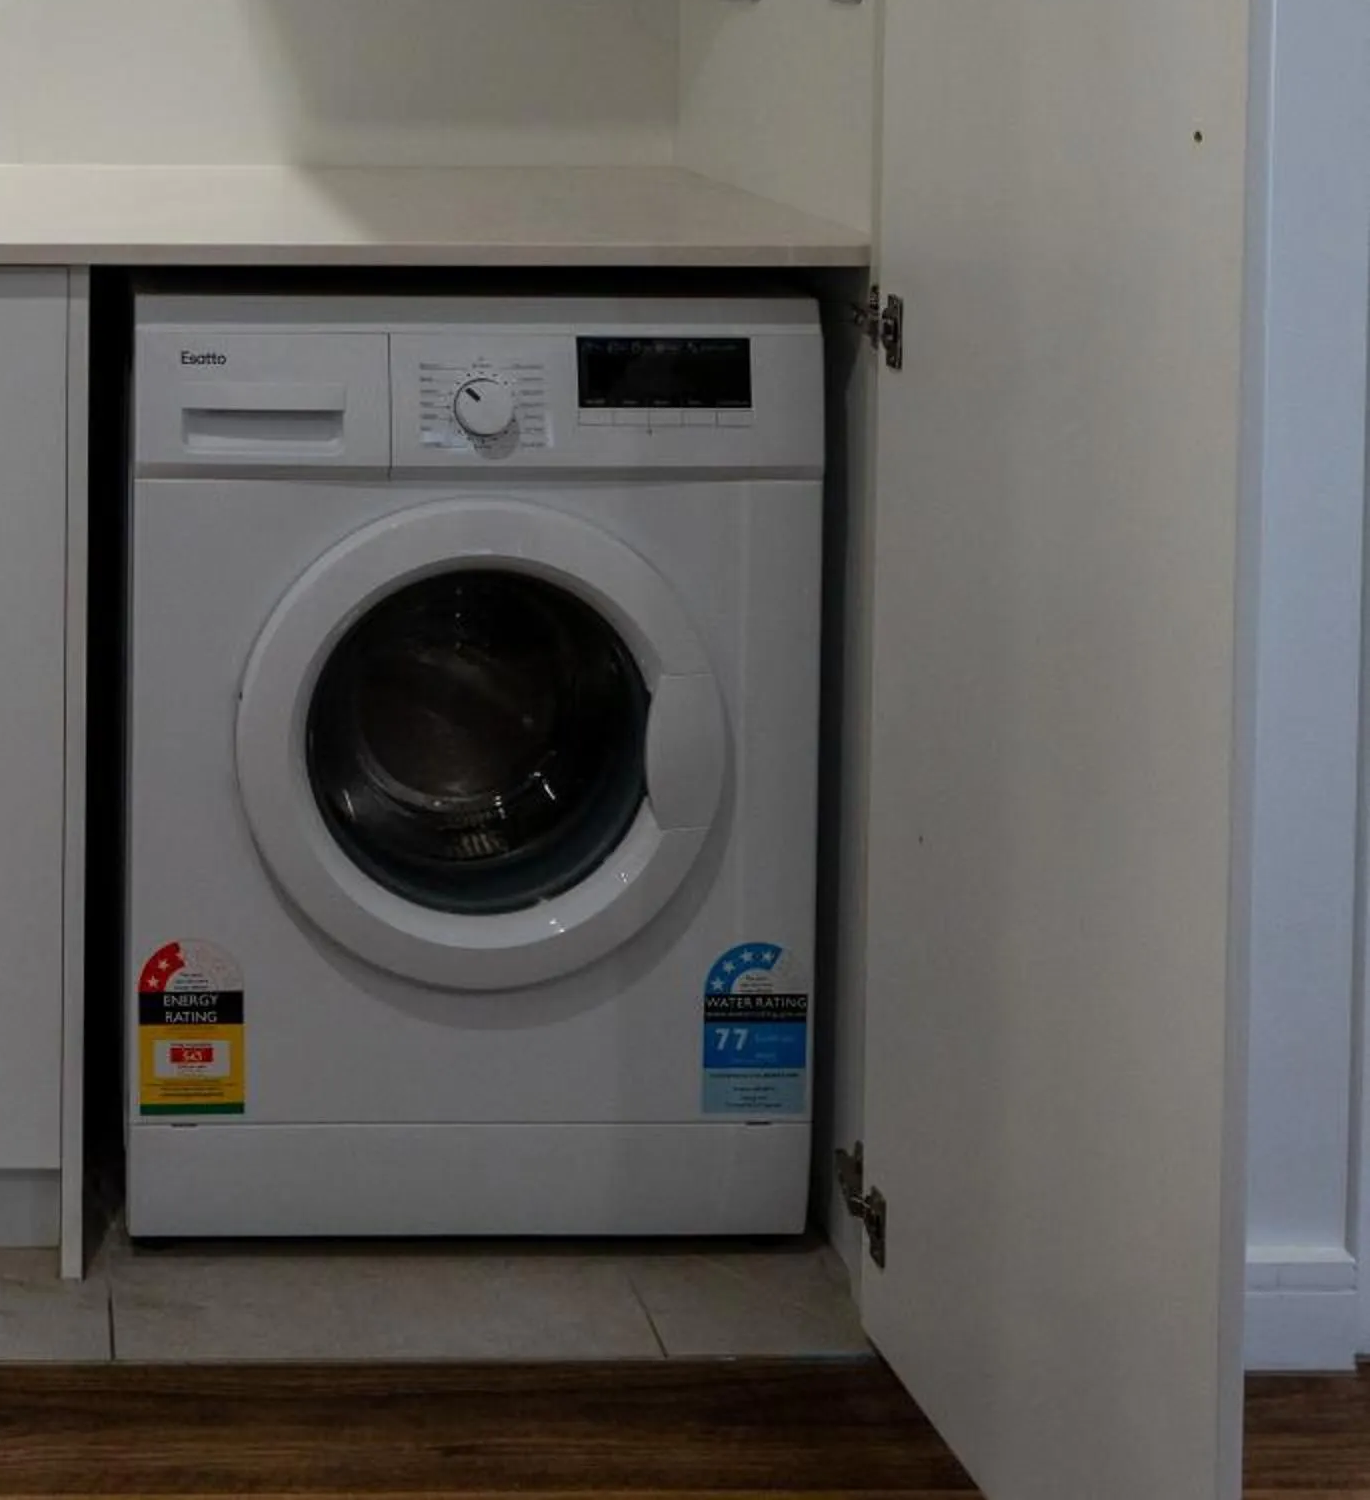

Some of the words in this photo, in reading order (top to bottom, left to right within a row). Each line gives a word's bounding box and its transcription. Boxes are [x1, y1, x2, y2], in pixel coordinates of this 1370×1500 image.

[180, 350, 228, 365] Esatto
[163, 994, 219, 1007] ENERGY
[706, 997, 753, 1009] WATER
[755, 997, 807, 1010] RATING
[165, 1011, 218, 1023] RATING
[714, 1027, 749, 1051] 77
